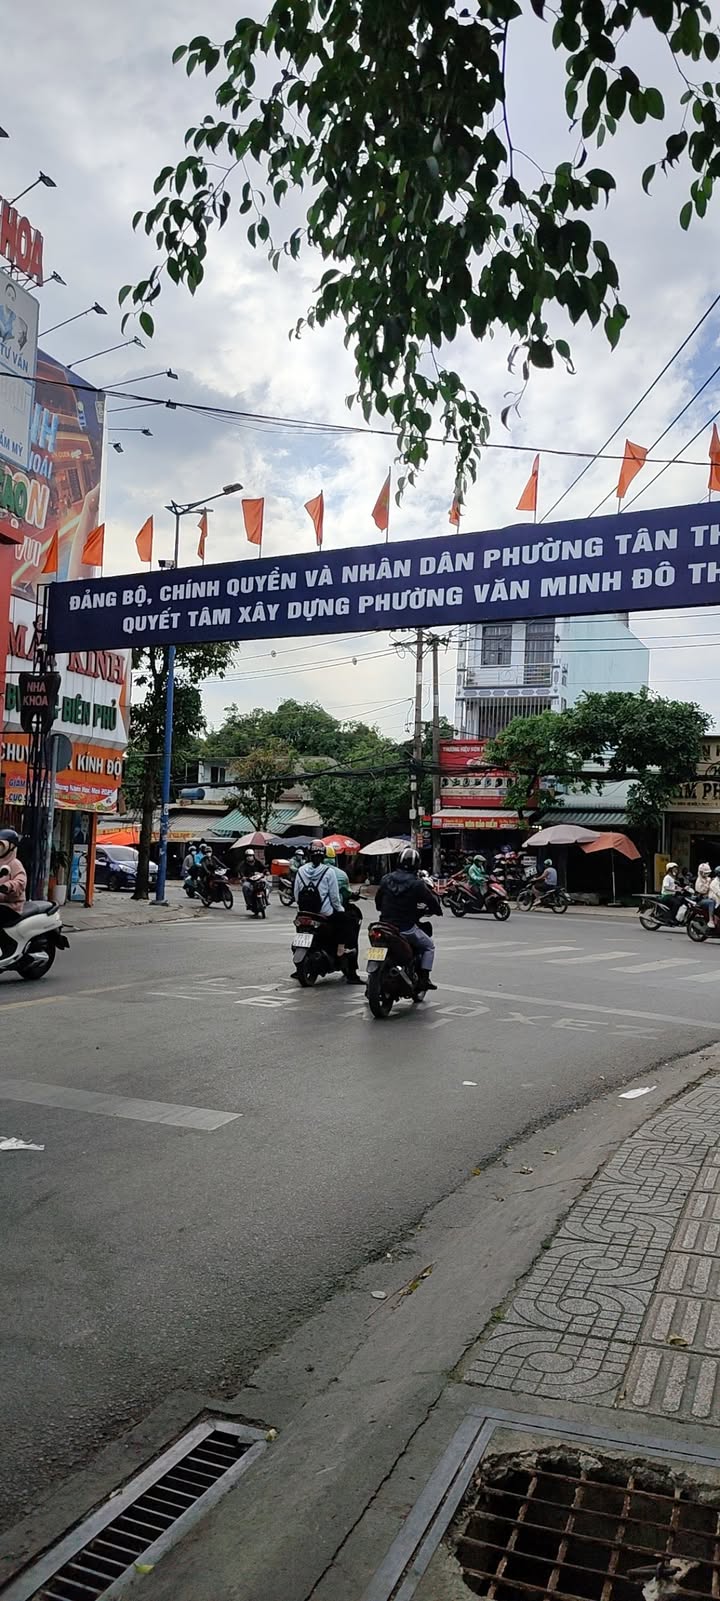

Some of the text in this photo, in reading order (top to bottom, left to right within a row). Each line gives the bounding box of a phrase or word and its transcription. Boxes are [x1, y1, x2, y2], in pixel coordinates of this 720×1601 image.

[0, 197, 43, 287] HOA
[69, 588, 118, 612] ĐẢNG
[122, 585, 154, 608] BỘ,
[159, 579, 220, 602] CHÍNH
[226, 566, 297, 597] QUYỀN
[305, 564, 334, 588] VÀ
[341, 557, 412, 584] NHÂN
[419, 551, 475, 576] DÂN
[483, 537, 604, 569] PHƯỜNG
[614, 527, 678, 555] TÂN
[122, 606, 181, 634] QUYẾT
[187, 606, 231, 627] TÂM
[238, 601, 280, 624] XÂY
[287, 597, 350, 621] DỰNG
[358, 585, 464, 614] PHƯỜNG
[473, 577, 530, 604] VĂN
[540, 570, 622, 598] MINH
[631, 560, 676, 590] ĐÔ
[23, 695, 49, 706] KHOA
[26, 682, 46, 692] NHA
[76, 752, 105, 774] KÍNH
